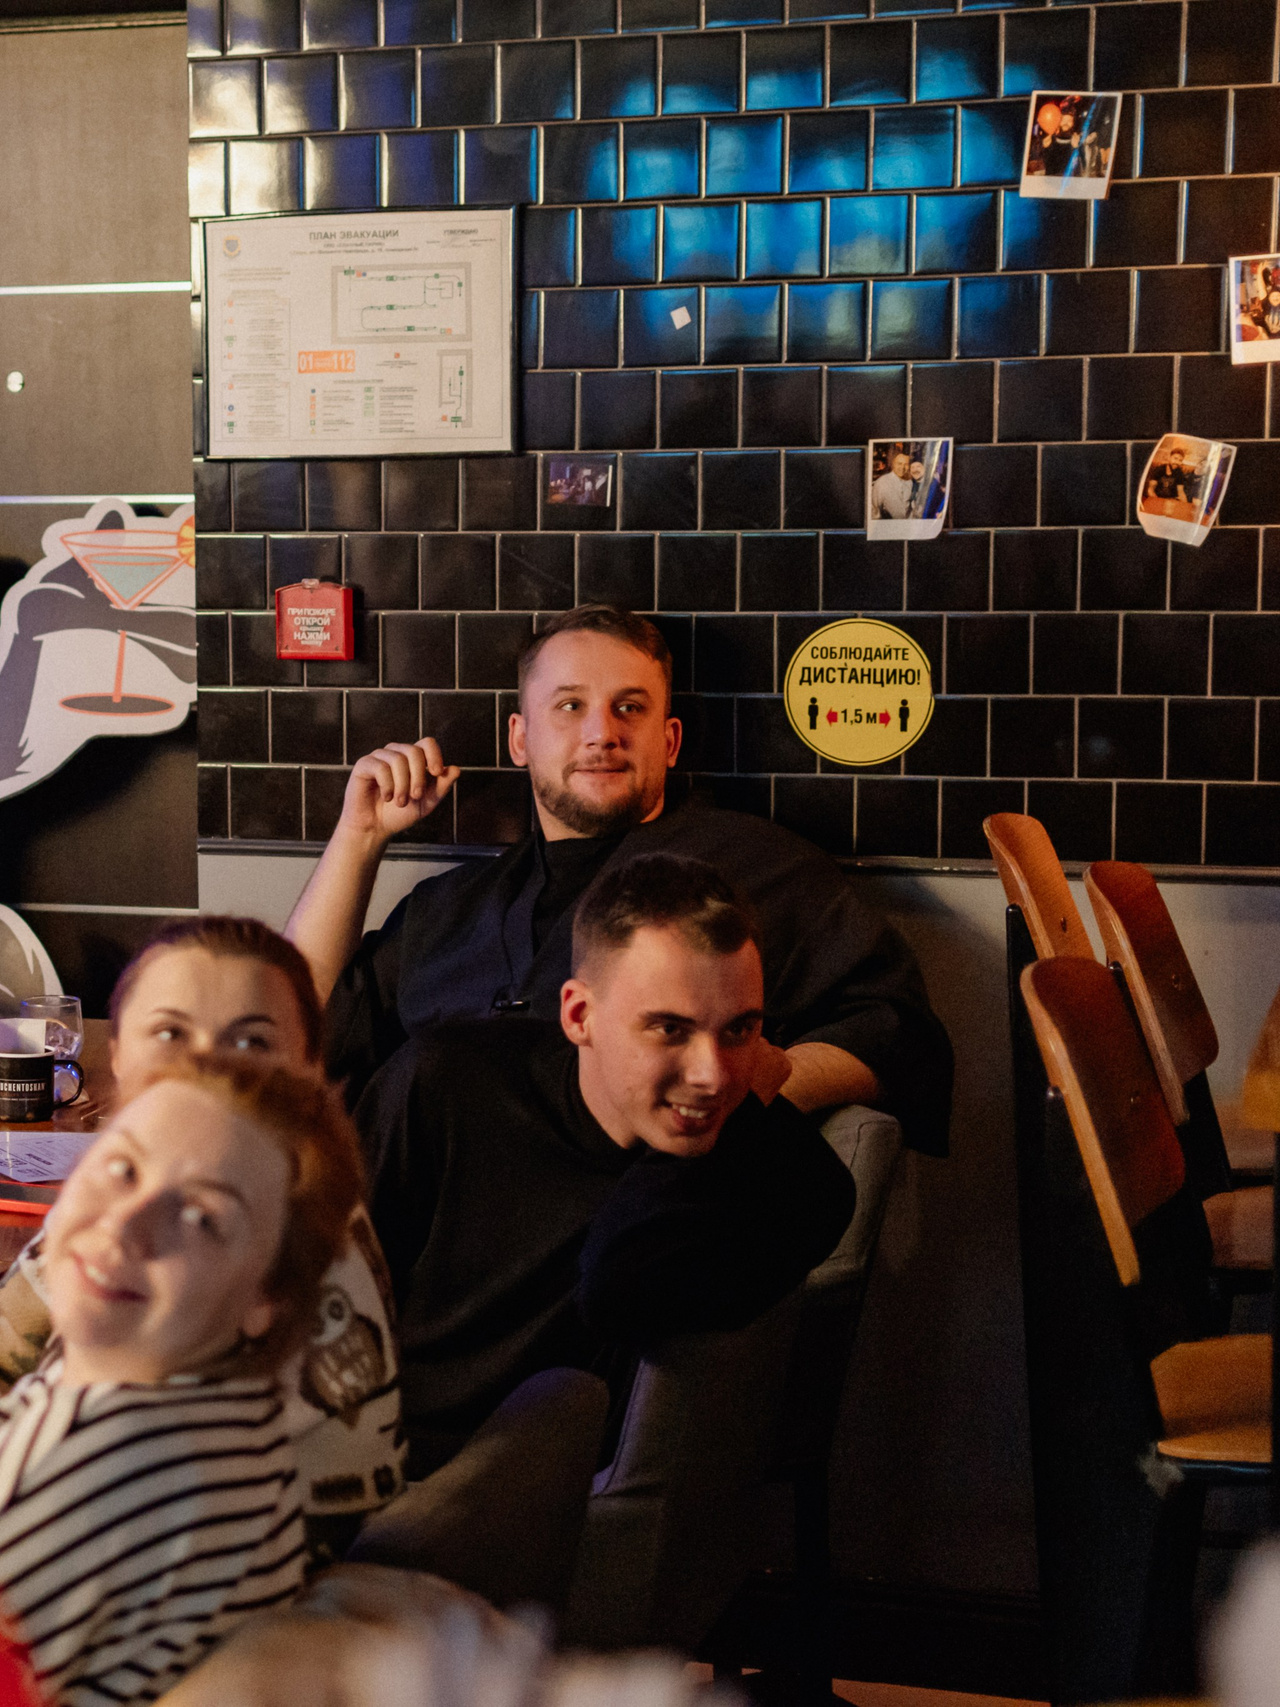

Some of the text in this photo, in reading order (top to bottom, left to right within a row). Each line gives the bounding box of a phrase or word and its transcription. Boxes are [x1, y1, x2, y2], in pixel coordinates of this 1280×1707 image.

[309, 229, 399, 240] ПЛАН ЭВАКУАЦИИ
[288, 608, 336, 616] ПРИ ПОЖАРЕ
[294, 616, 330, 625] ОТКРОЙ
[294, 631, 330, 640] НАЖМИ
[811, 644, 909, 662] СОБЛЮДАЙТЕ
[799, 666, 920, 688] ДИСТАНЦИЮ!
[841, 708, 863, 726] 1,5
